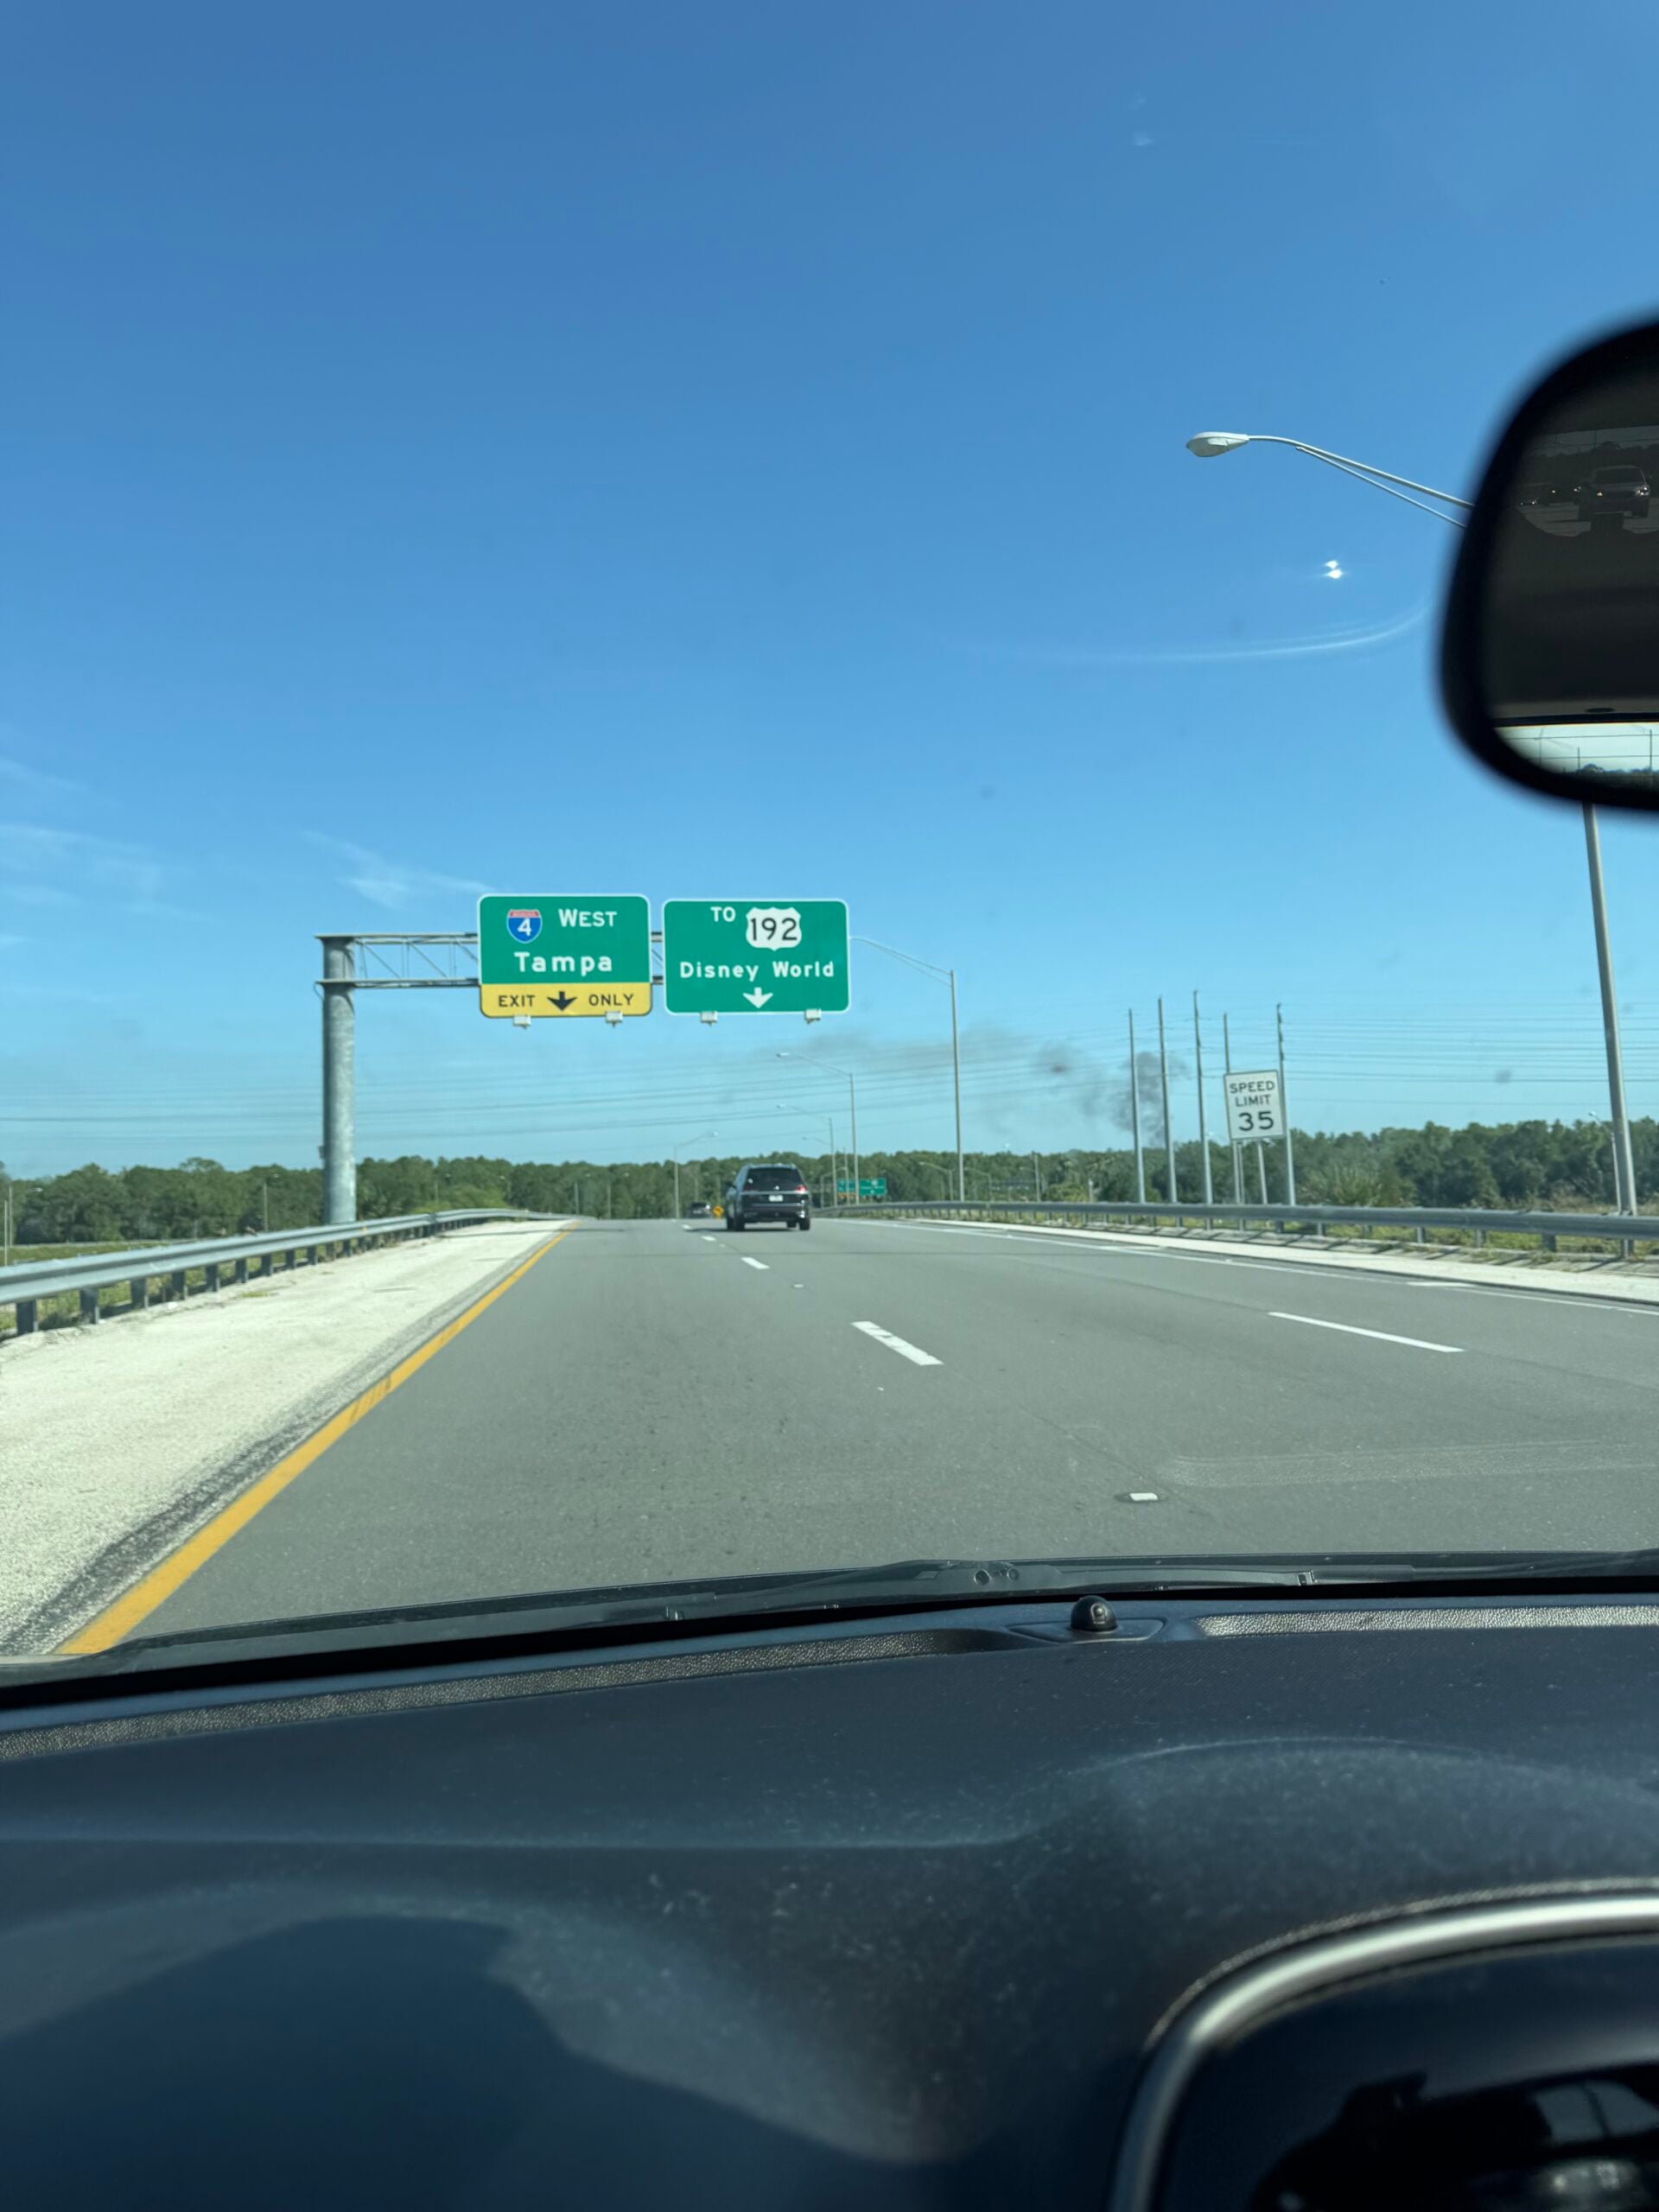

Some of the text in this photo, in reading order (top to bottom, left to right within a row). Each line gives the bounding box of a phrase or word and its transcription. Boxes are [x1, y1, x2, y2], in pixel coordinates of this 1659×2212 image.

[518, 908, 618, 936] 4 WEST
[710, 906, 798, 941] TO 192
[513, 951, 613, 976] Tampa
[680, 961, 835, 983] Disney World
[498, 994, 635, 1007] EXIT ONLY
[1229, 1081, 1275, 1094] SPEED
[1235, 1094, 1271, 1107] LIMIT
[1238, 1111, 1274, 1131] 35
